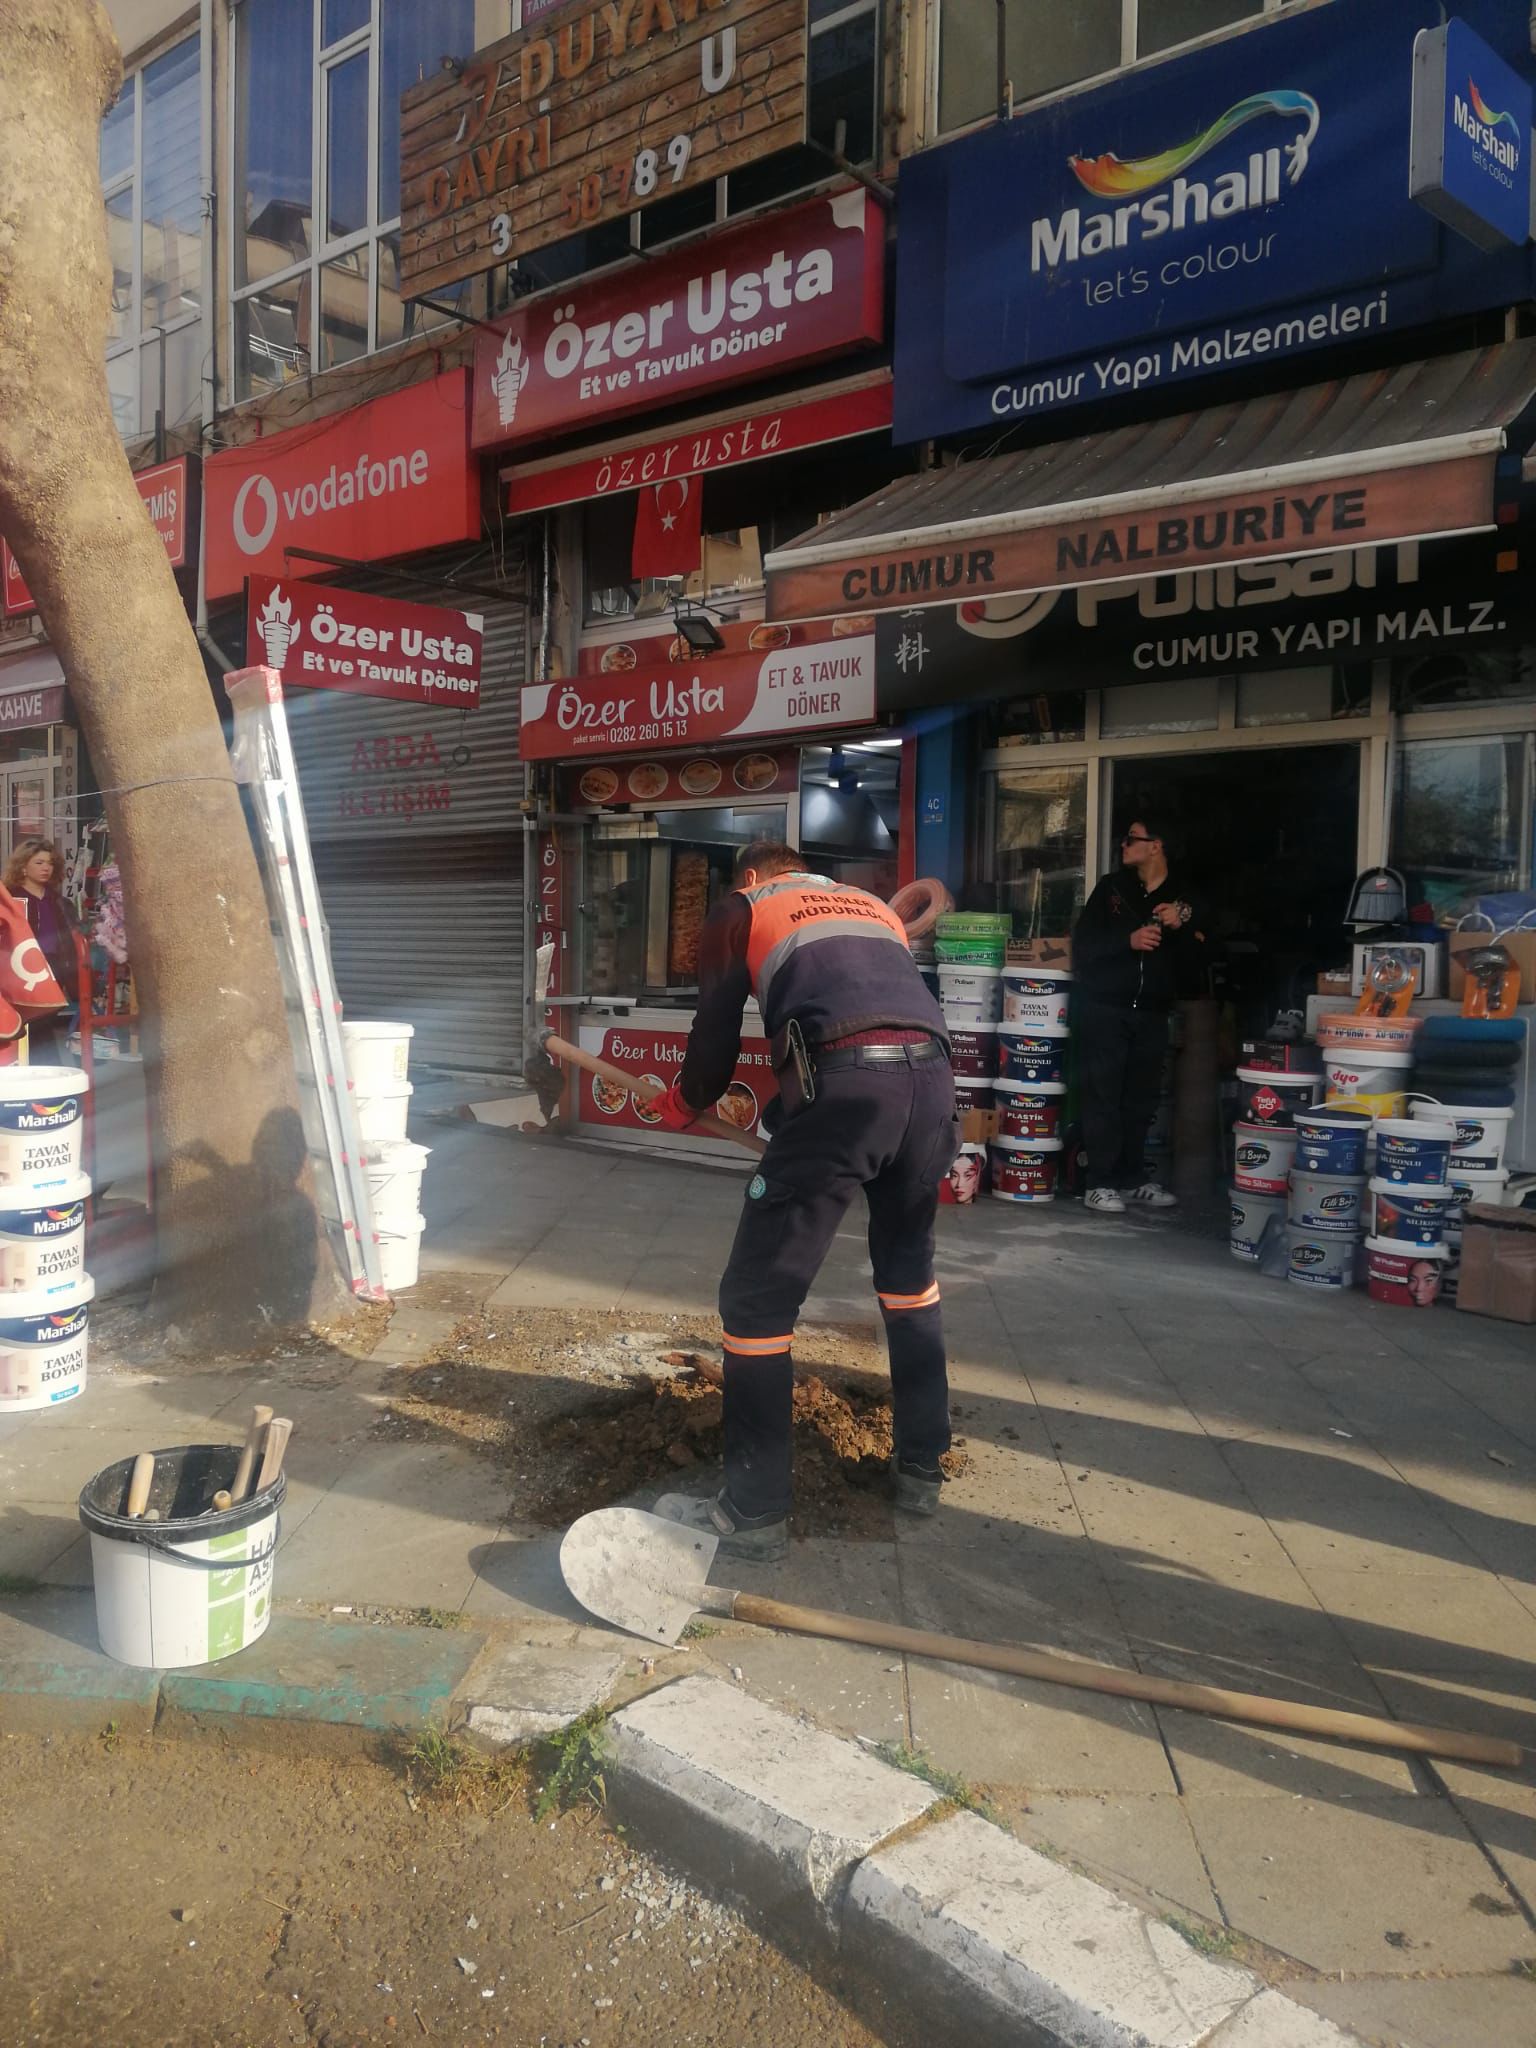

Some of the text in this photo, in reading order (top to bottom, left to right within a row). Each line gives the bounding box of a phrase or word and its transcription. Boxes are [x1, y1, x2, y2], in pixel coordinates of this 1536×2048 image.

[1454, 94, 1515, 172] Marshall
[1488, 163, 1513, 190] colour
[1031, 148, 1281, 273] Marshall
[1160, 233, 1278, 288] colour
[543, 248, 834, 380] Özer Usta
[579, 321, 788, 401] Et ve Tavuk Döner
[992, 291, 1389, 416] Cumur Yapı Malzemeleri
[595, 417, 784, 493] özer usta
[282, 448, 430, 522] vodafone
[841, 488, 1367, 602] CUMUR NALBURİYE
[309, 603, 474, 667] Özer Usta
[1132, 600, 1508, 671] CUMUR YAPI MALZ.
[303, 651, 479, 694] Et ve Tavuk Döner
[768, 656, 863, 690] ET & TAVUK
[556, 676, 725, 731] Özer Usta
[786, 688, 842, 719] DÖNER
[610, 725, 637, 744] 0282
[639, 722, 659, 740] 260
[662, 721, 673, 738] 15
[676, 719, 688, 737] 13
[800, 894, 828, 904] FEN
[1020, 985, 1054, 994] Marshall
[611, 1036, 648, 1060] Özer
[1016, 1043, 1049, 1053] Marshall
[1332, 1070, 1359, 1085] dyo
[1010, 1099, 1043, 1109] Marshall
[18, 1110, 75, 1128] Marshall
[1007, 1112, 1044, 1121] PLASTİK
[25, 1142, 70, 1159] TAVAN
[1384, 1142, 1418, 1153] Marshall
[22, 1154, 72, 1171] BOYASI
[1009, 1156, 1042, 1166] Marshall
[1005, 1169, 1043, 1178] PLASTİK
[34, 1213, 84, 1235] Marshall
[37, 1255, 80, 1277] BOYASI
[40, 1245, 79, 1264] TAVAN
[37, 1316, 87, 1342] Marshall
[41, 1360, 84, 1383] BOYASI
[44, 1349, 82, 1371] TAVAN
